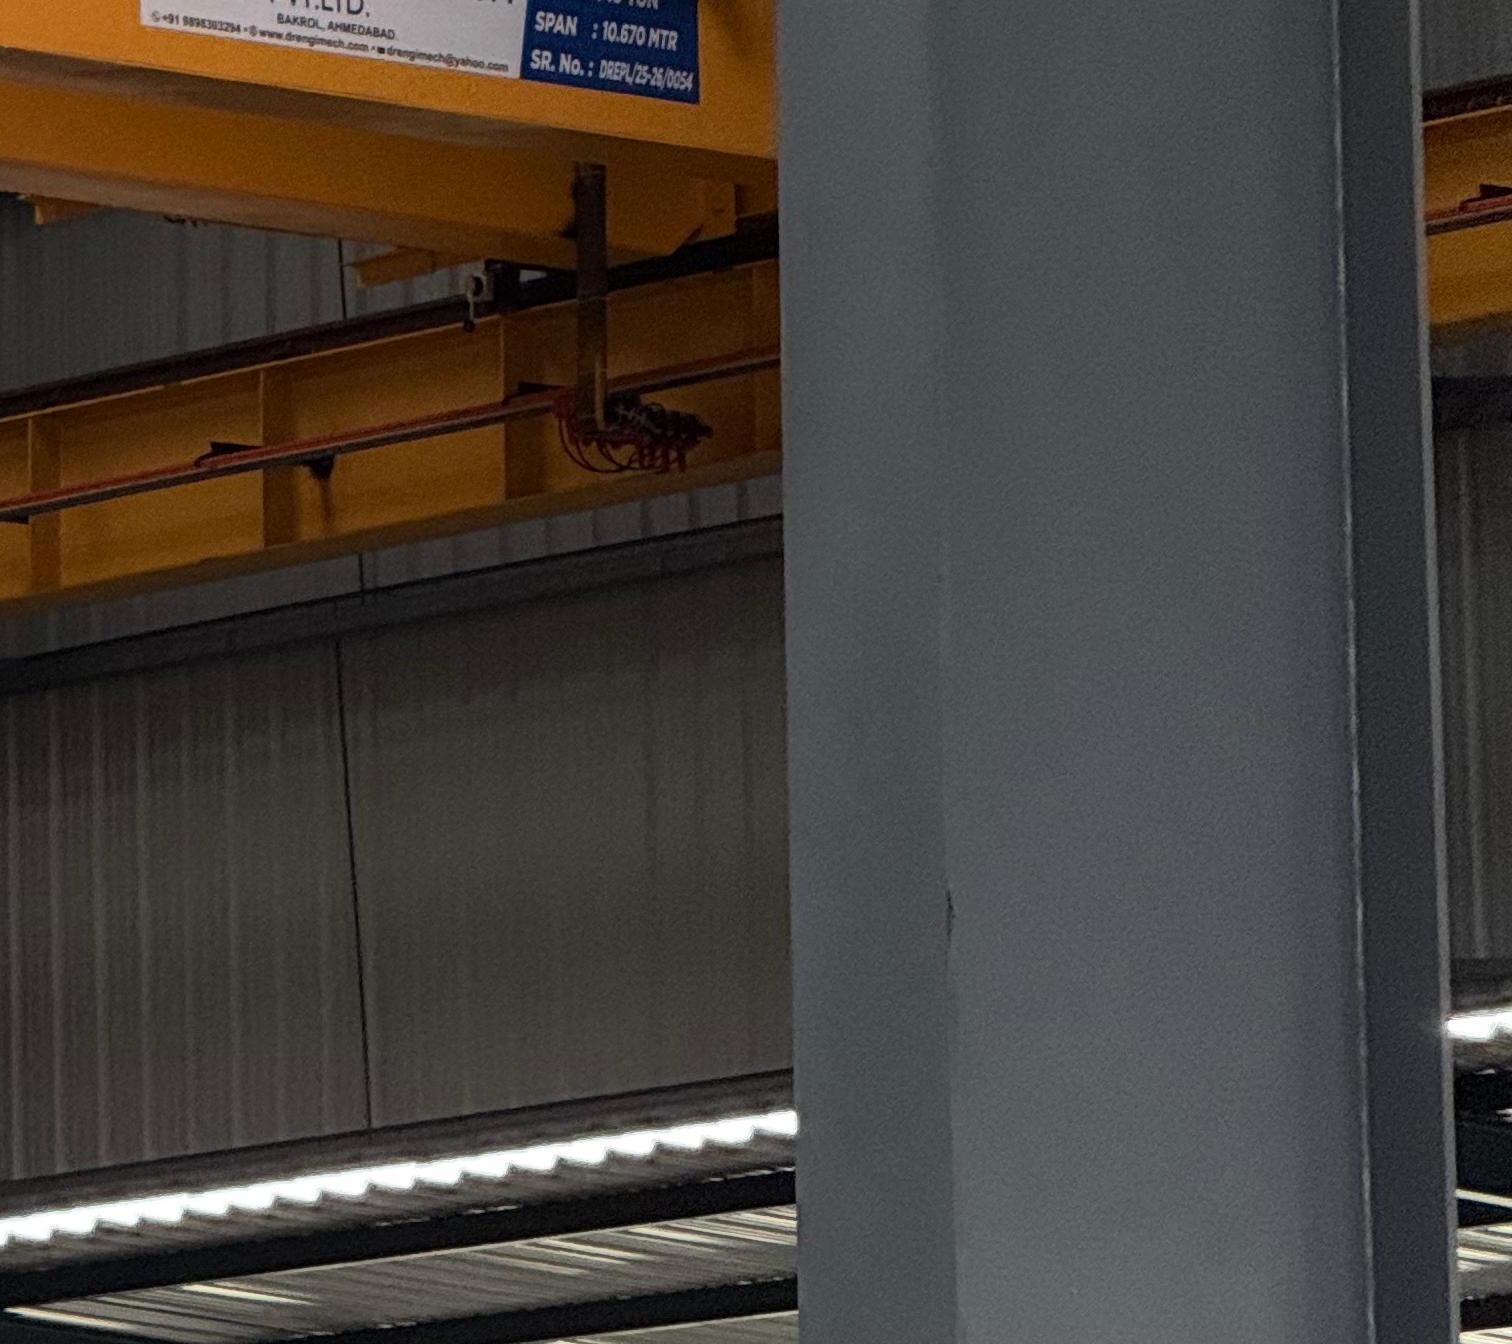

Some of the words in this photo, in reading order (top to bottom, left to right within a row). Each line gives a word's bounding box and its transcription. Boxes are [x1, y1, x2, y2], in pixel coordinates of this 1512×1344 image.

[534, 11, 578, 36] SPAN
[602, 21, 646, 47] 10.670
[648, 27, 679, 52] MTR
[529, 49, 556, 72] SR.
